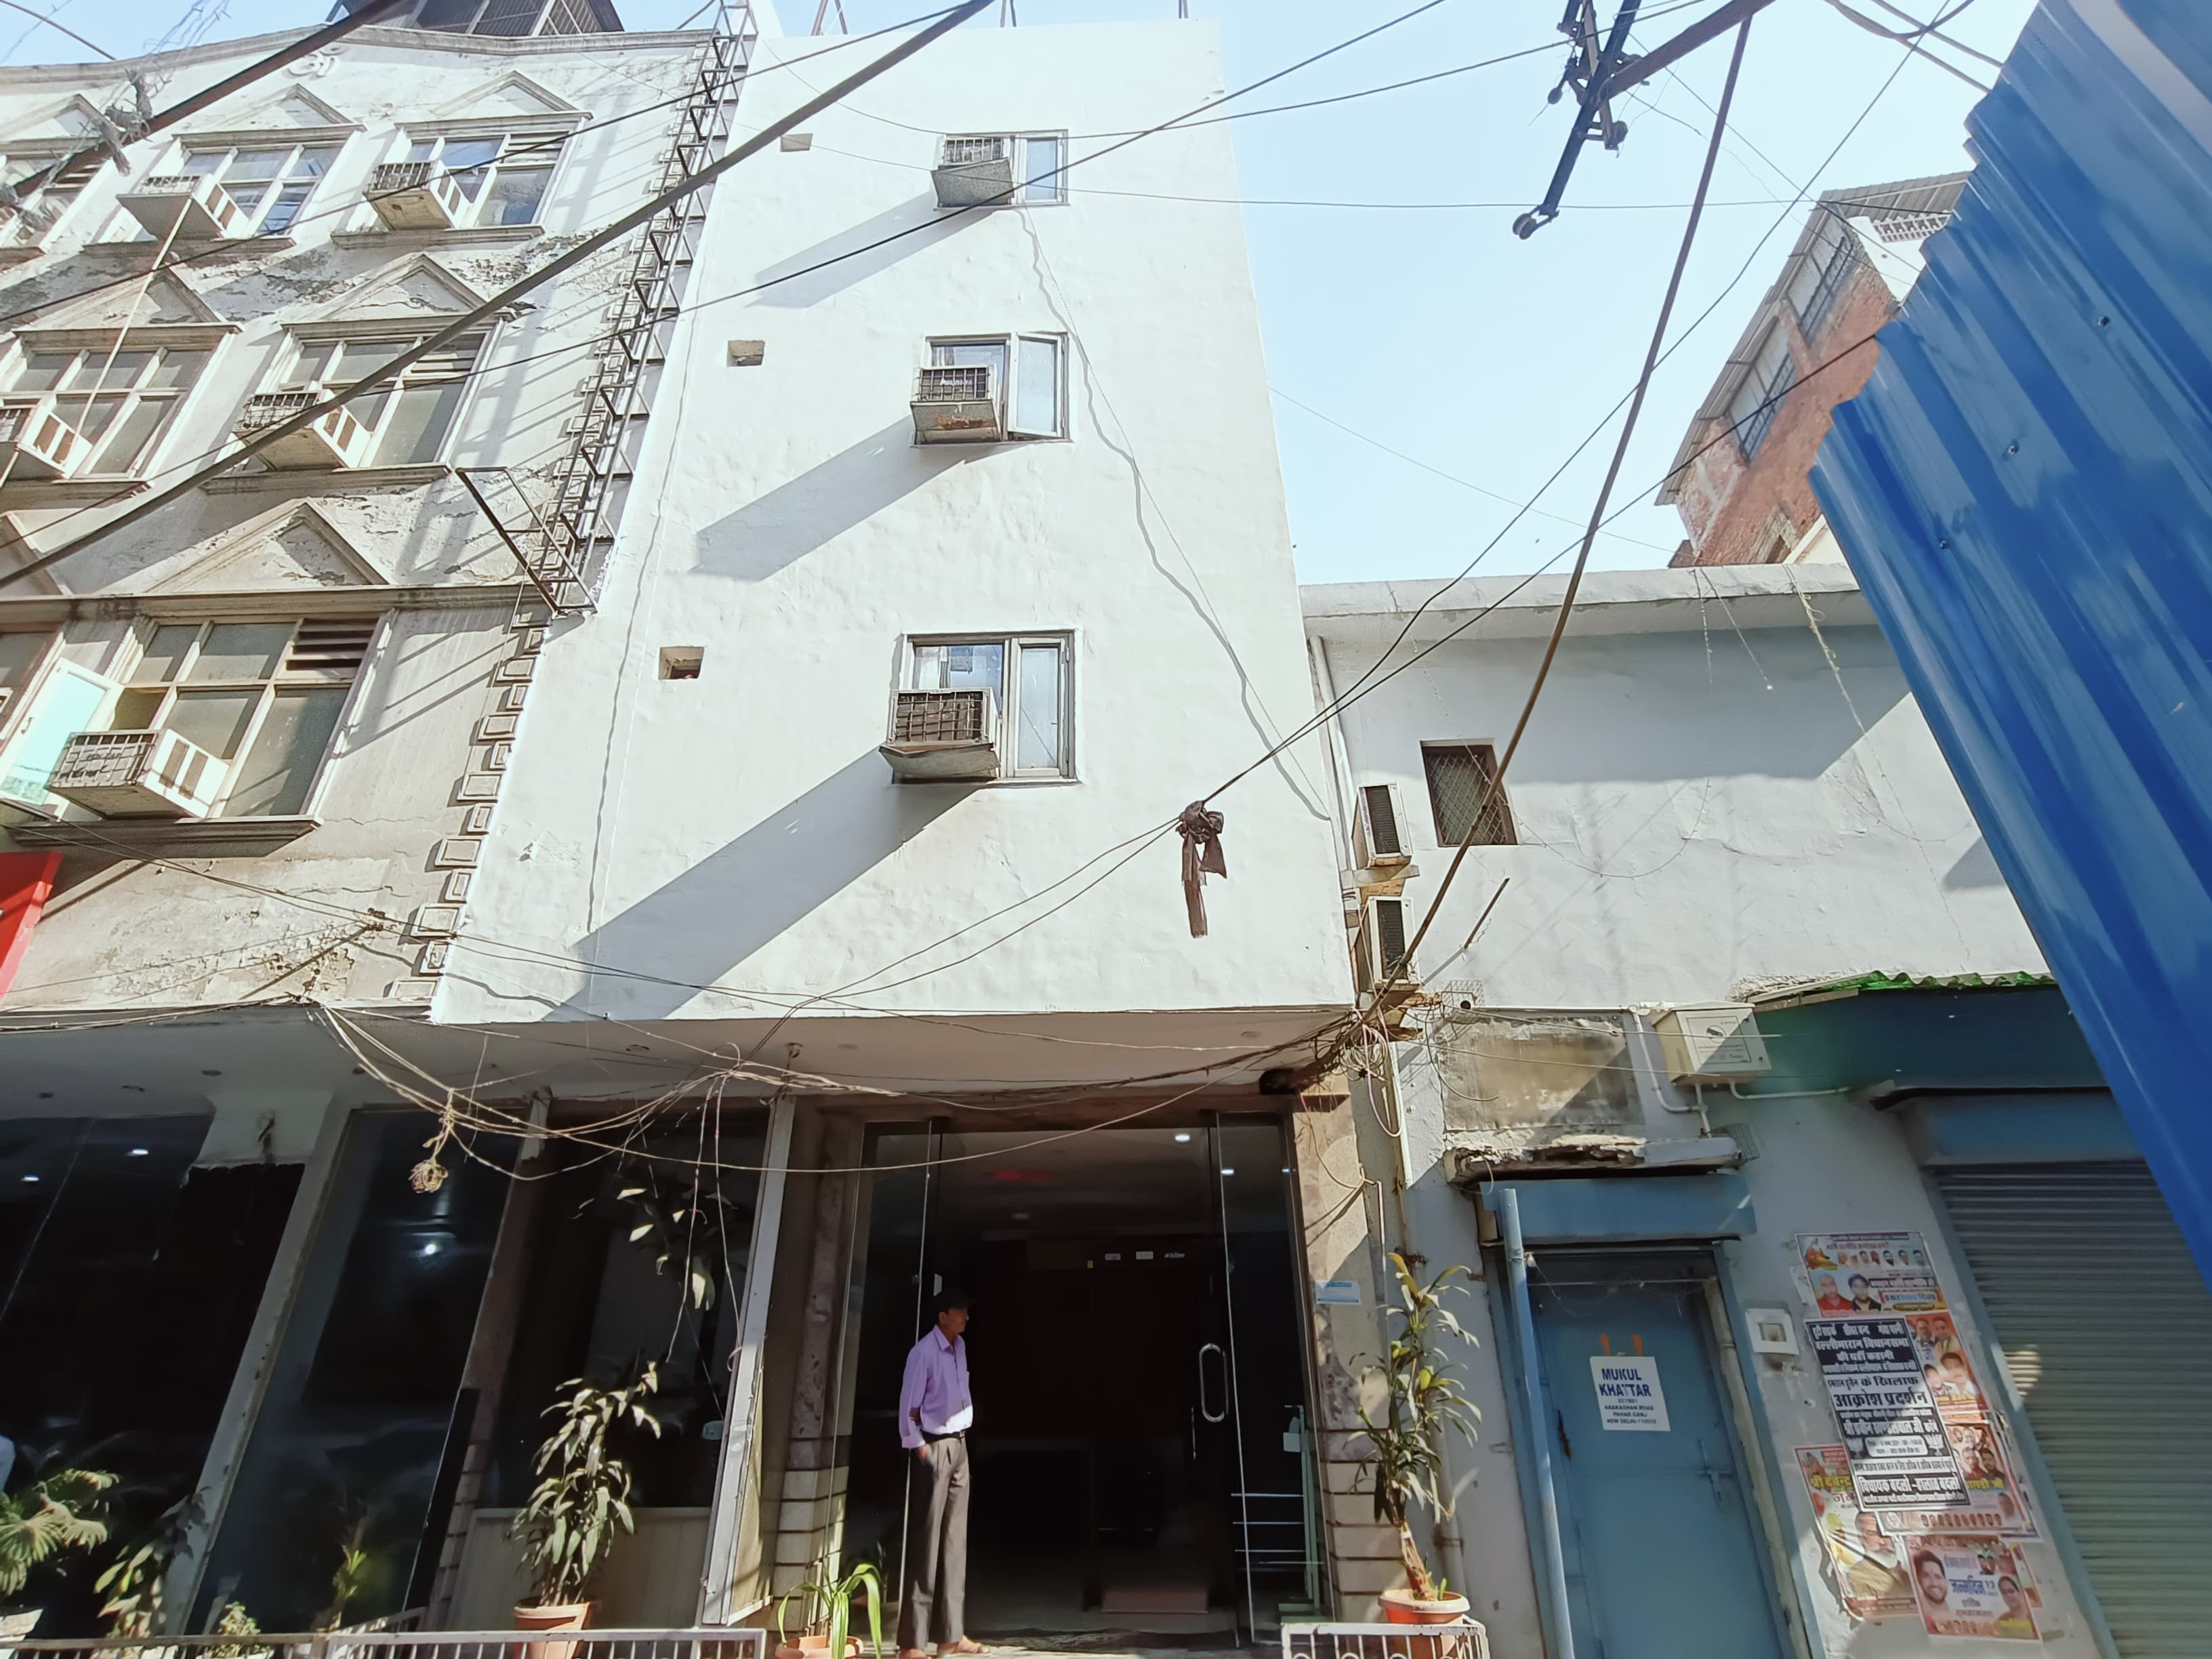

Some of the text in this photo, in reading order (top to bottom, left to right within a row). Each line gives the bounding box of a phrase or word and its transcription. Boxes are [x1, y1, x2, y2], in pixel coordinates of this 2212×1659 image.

[1601, 1368, 1642, 1380] MUKUL
[1861, 1376, 1872, 1387] के
[1873, 1376, 1919, 1387] खिलाफ
[1833, 1387, 1928, 1408] आक्रोश प्रदर्शन
